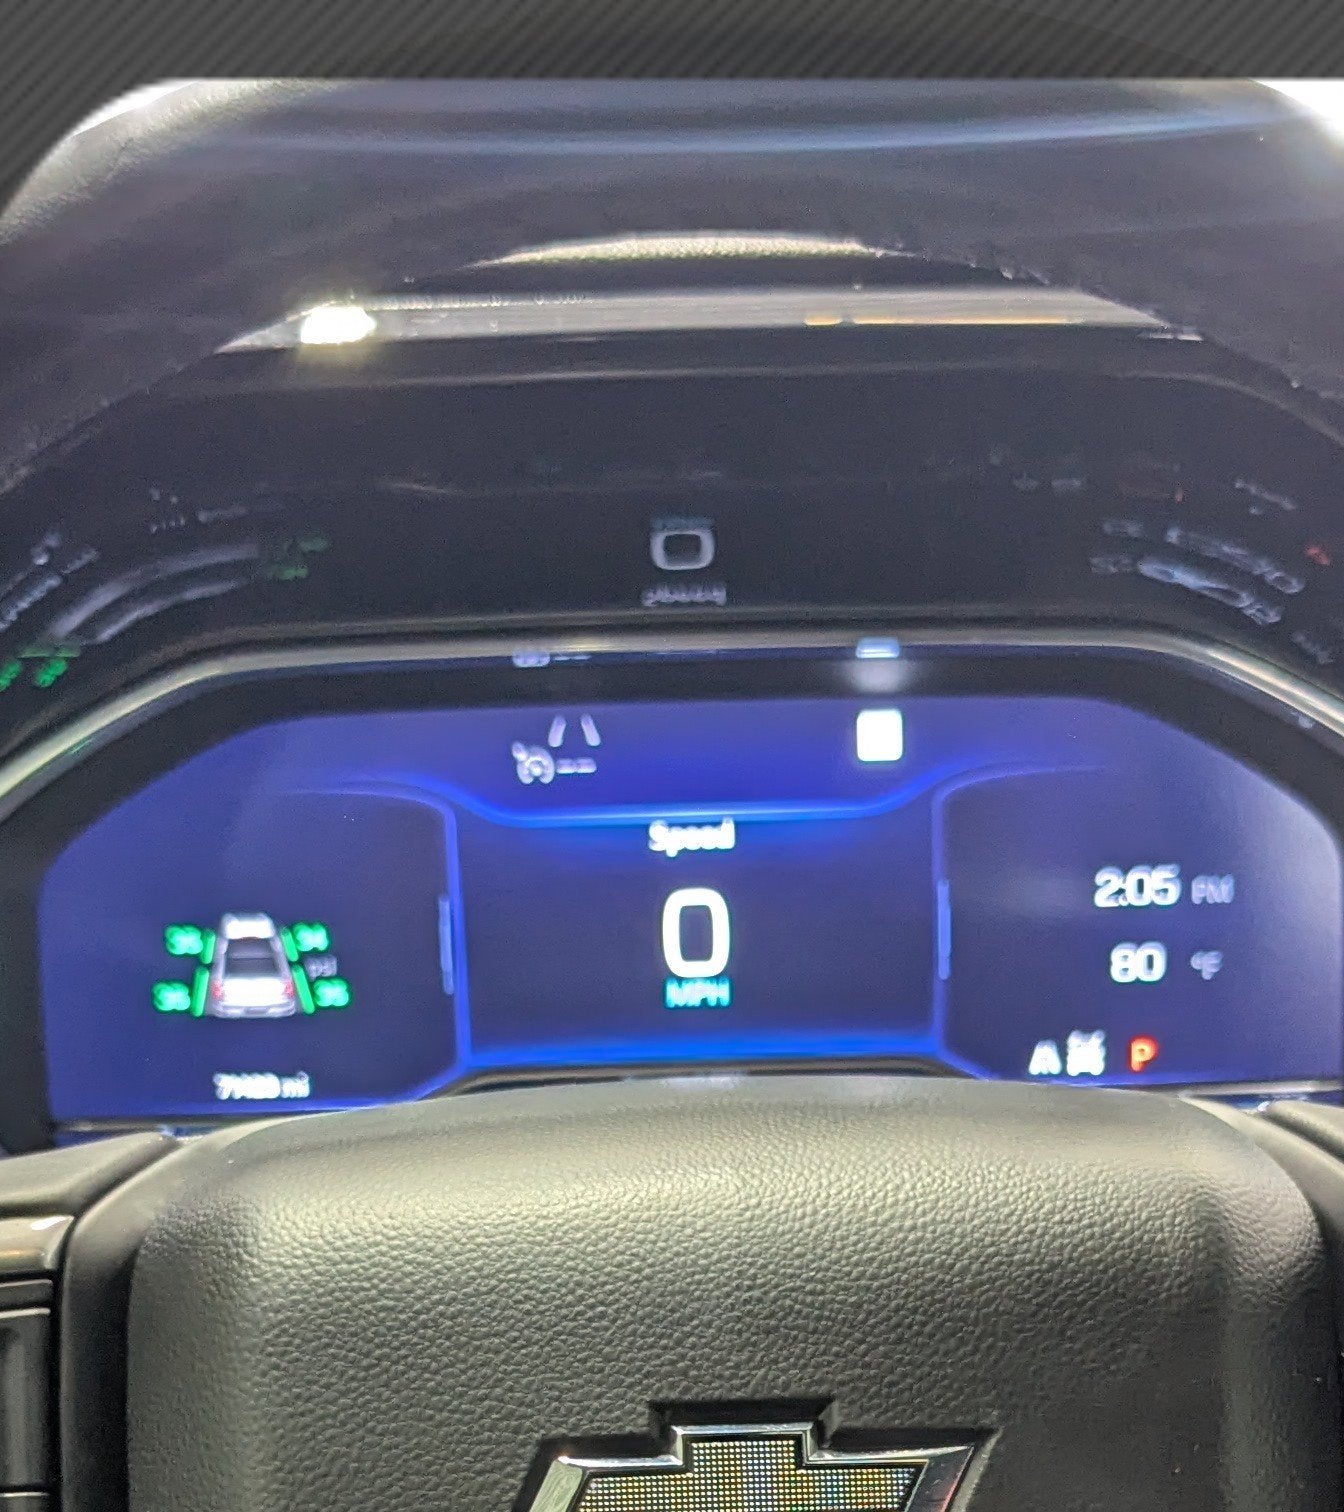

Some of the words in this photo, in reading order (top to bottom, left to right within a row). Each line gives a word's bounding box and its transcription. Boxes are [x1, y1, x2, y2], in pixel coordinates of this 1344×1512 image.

[648, 817, 736, 858] Speed
[1094, 864, 1182, 908] 2:05
[1190, 873, 1236, 905] PM
[661, 887, 731, 979] 0
[1110, 941, 1167, 983] 80
[664, 976, 731, 1009] MPH
[1128, 1034, 1159, 1073] P
